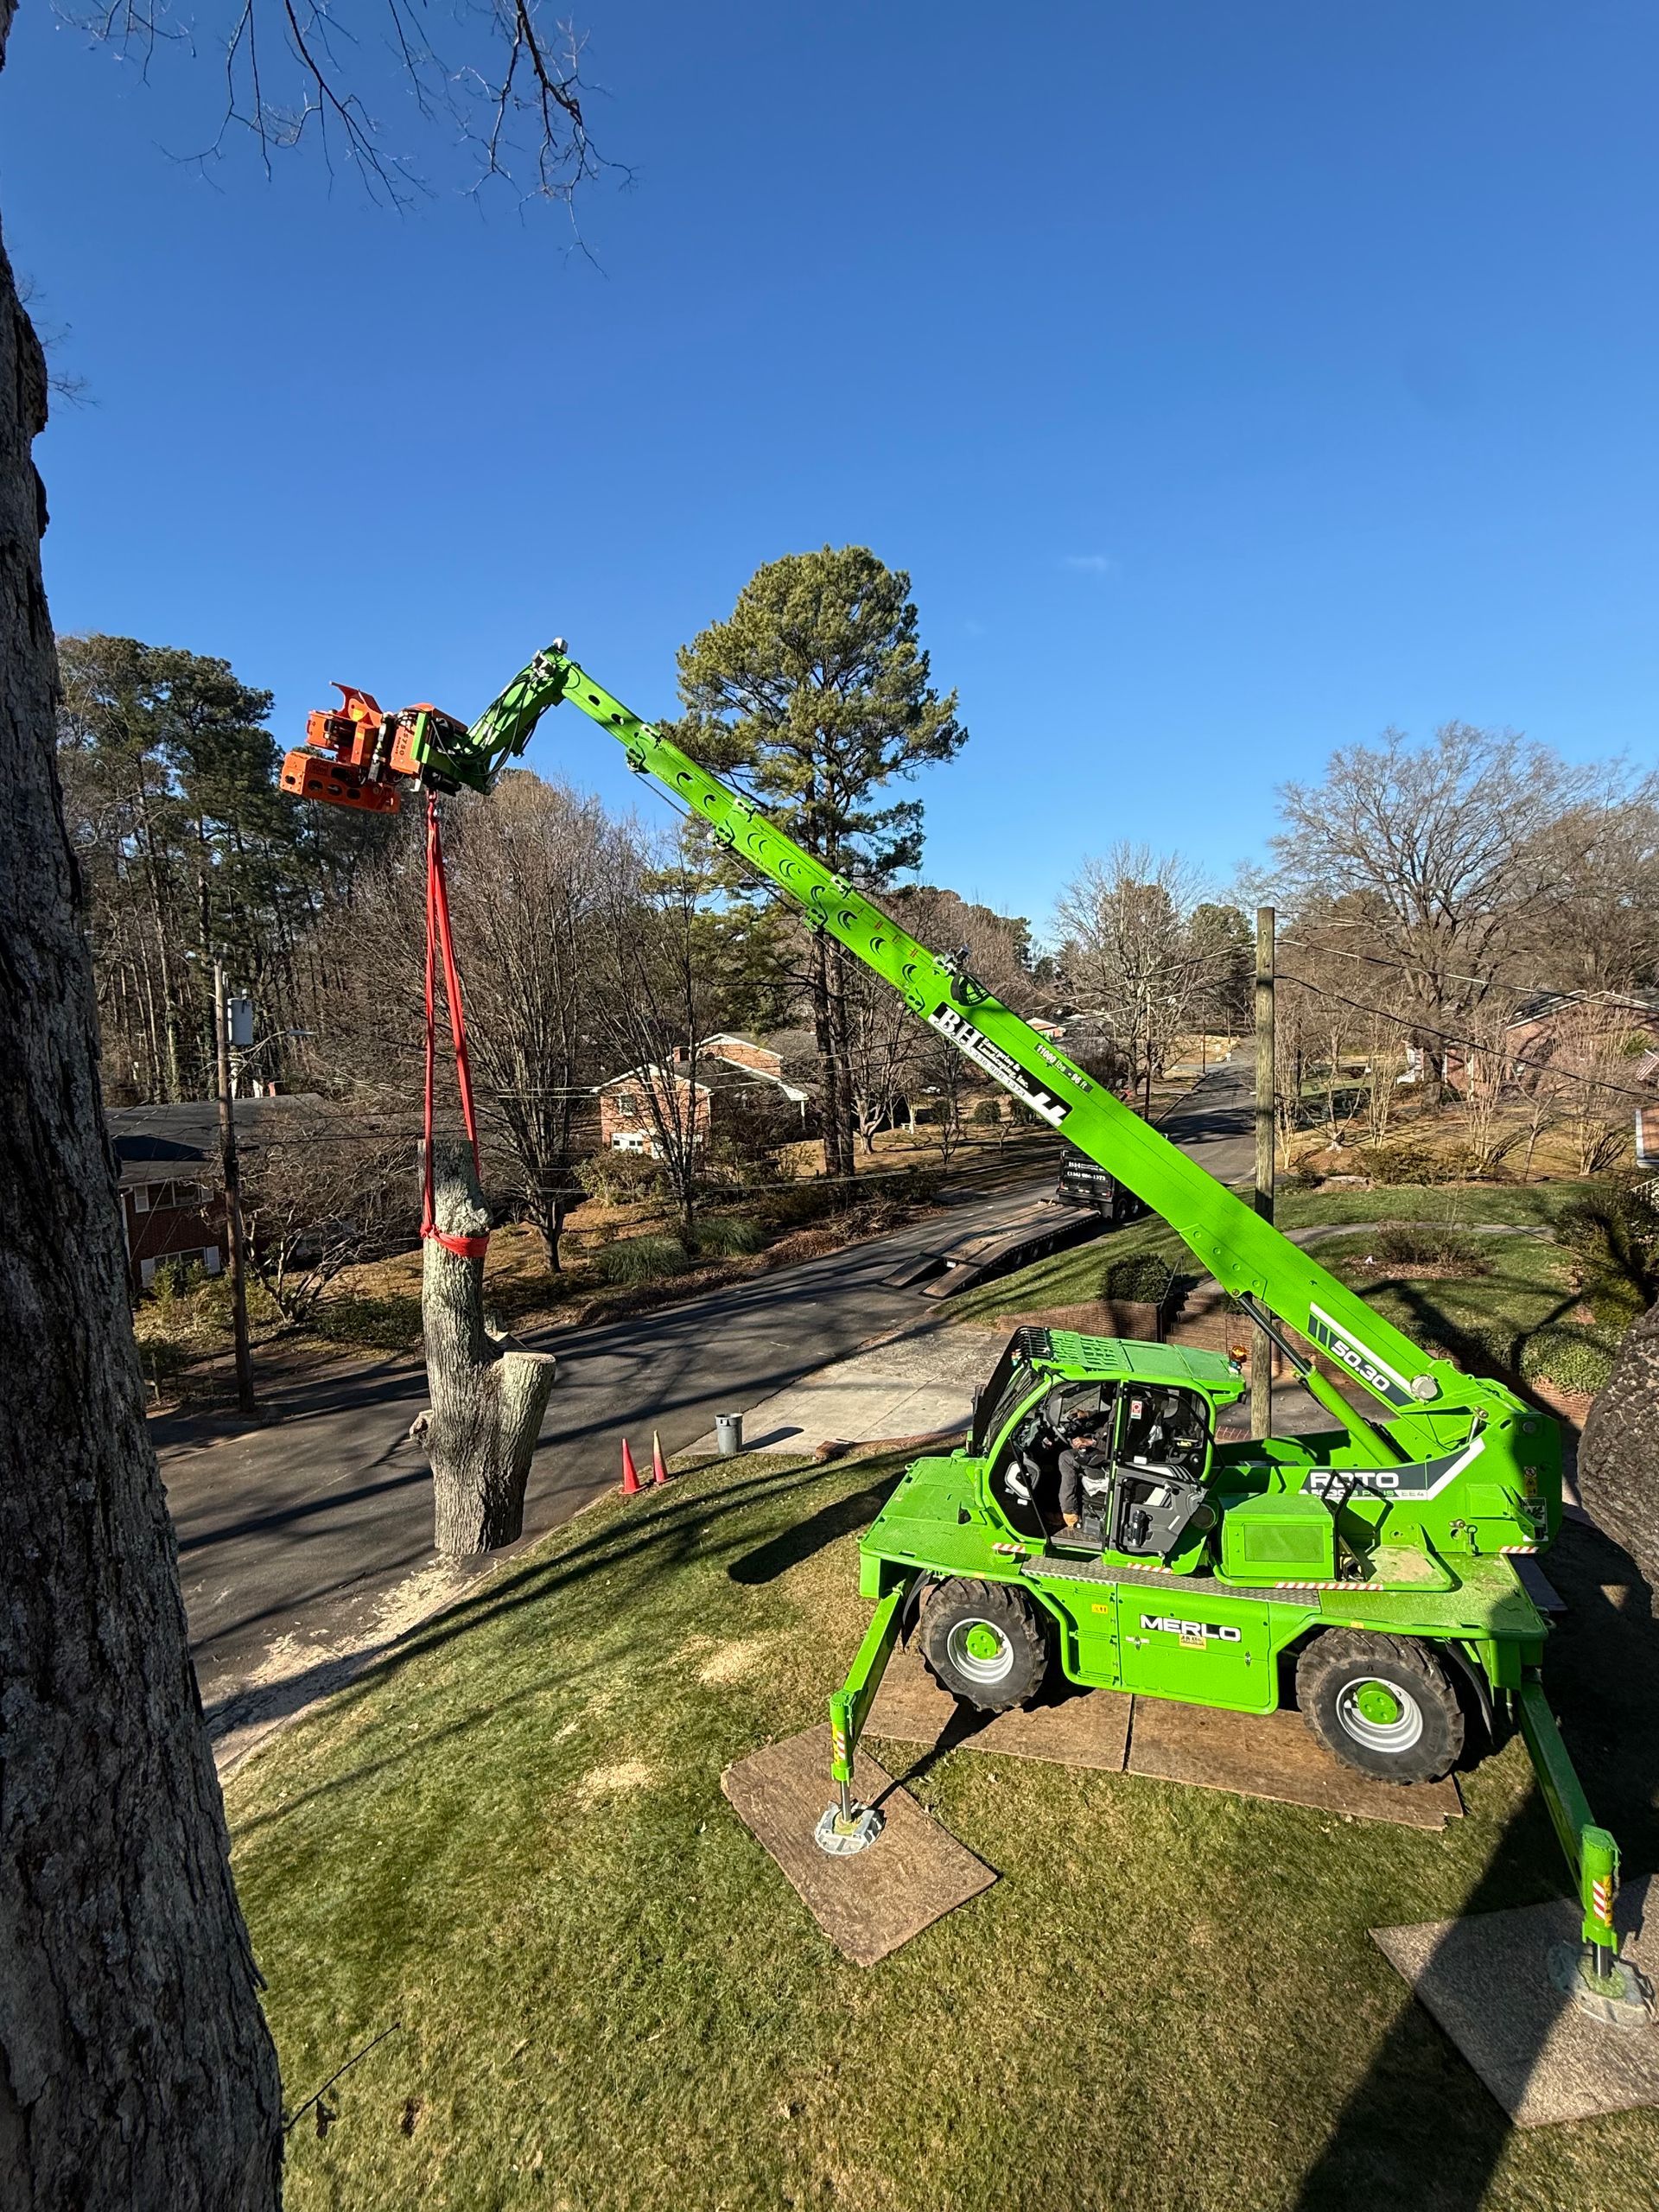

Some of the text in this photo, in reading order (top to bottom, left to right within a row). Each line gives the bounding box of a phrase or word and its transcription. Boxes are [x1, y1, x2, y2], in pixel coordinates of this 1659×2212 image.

[933, 1006, 984, 1052] BH
[973, 1052, 988, 1066] 336
[976, 1043, 1029, 1089] Landscaping, Inc.
[982, 1037, 1021, 1072] Enterprise &
[1036, 1045, 1058, 1064] 11000
[1054, 1059, 1067, 1072] lbs
[1079, 1080, 1089, 1090] ft
[1331, 1340, 1390, 1391] 50.30
[1310, 1471, 1400, 1488] ROTO
[1140, 1613, 1242, 1643] MERLO
